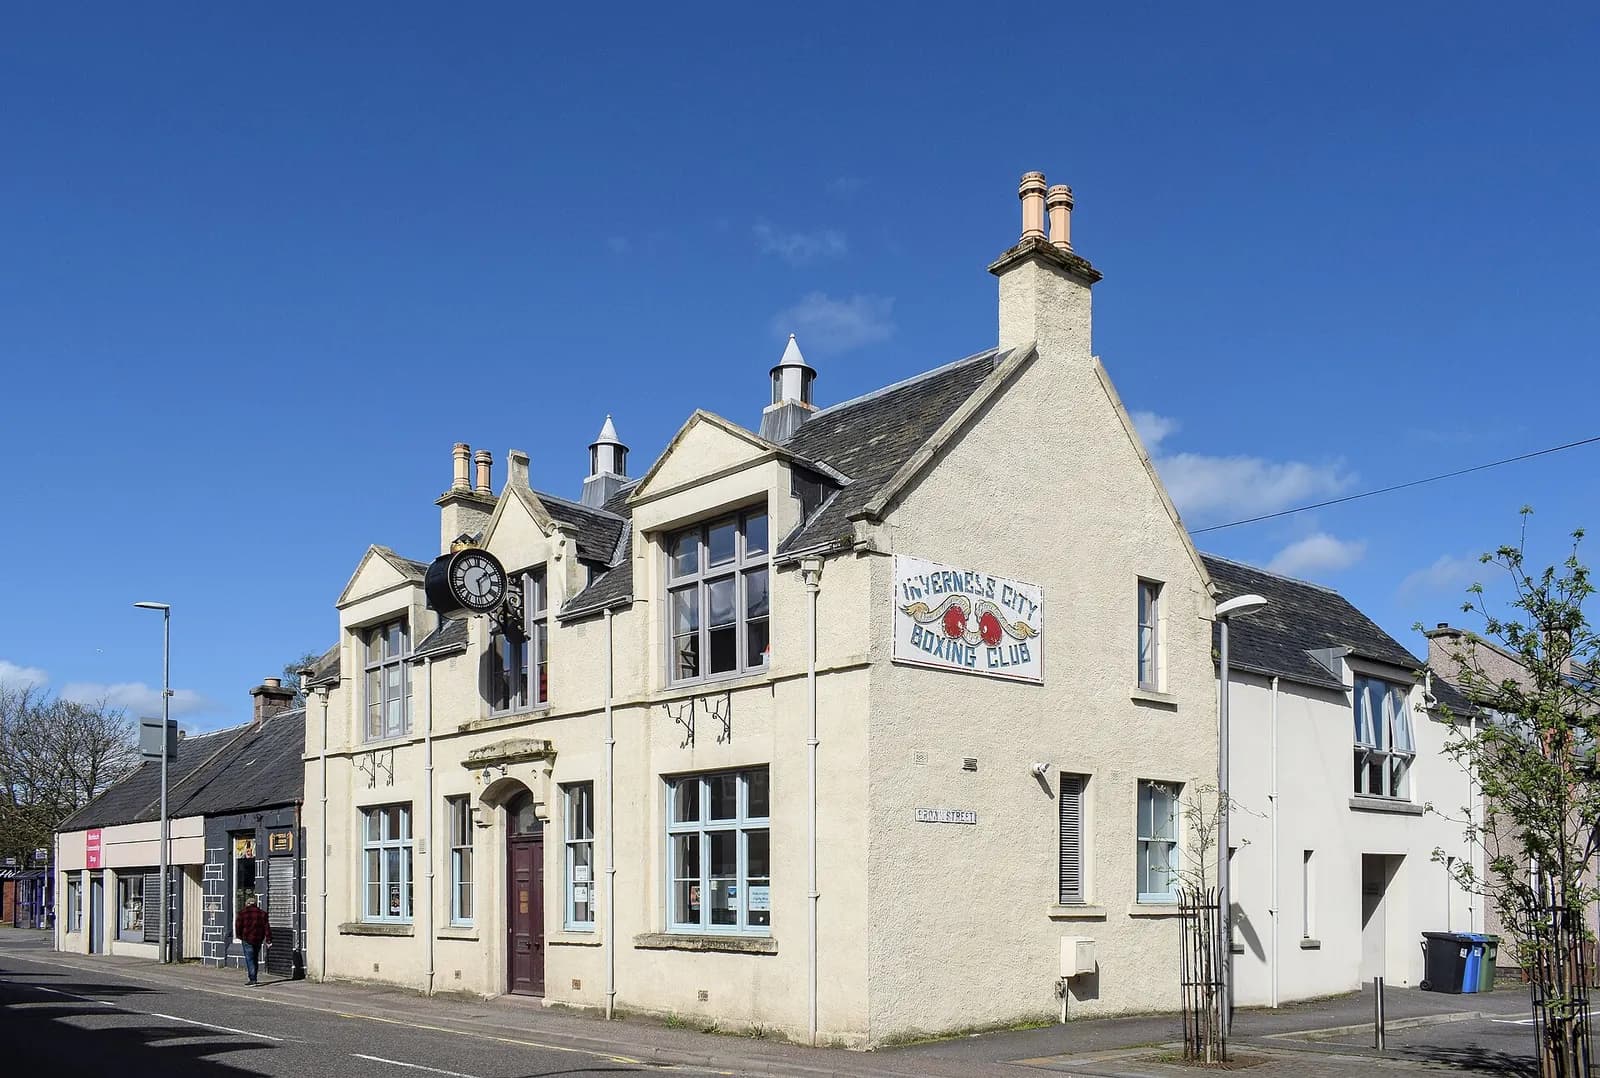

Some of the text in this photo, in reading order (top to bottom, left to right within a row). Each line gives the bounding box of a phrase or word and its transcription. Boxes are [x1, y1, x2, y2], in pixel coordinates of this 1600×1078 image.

[902, 571, 1038, 621] INVERNESS CITY
[911, 624, 1031, 668] BOXING CLUB
[946, 811, 973, 822] STREET
